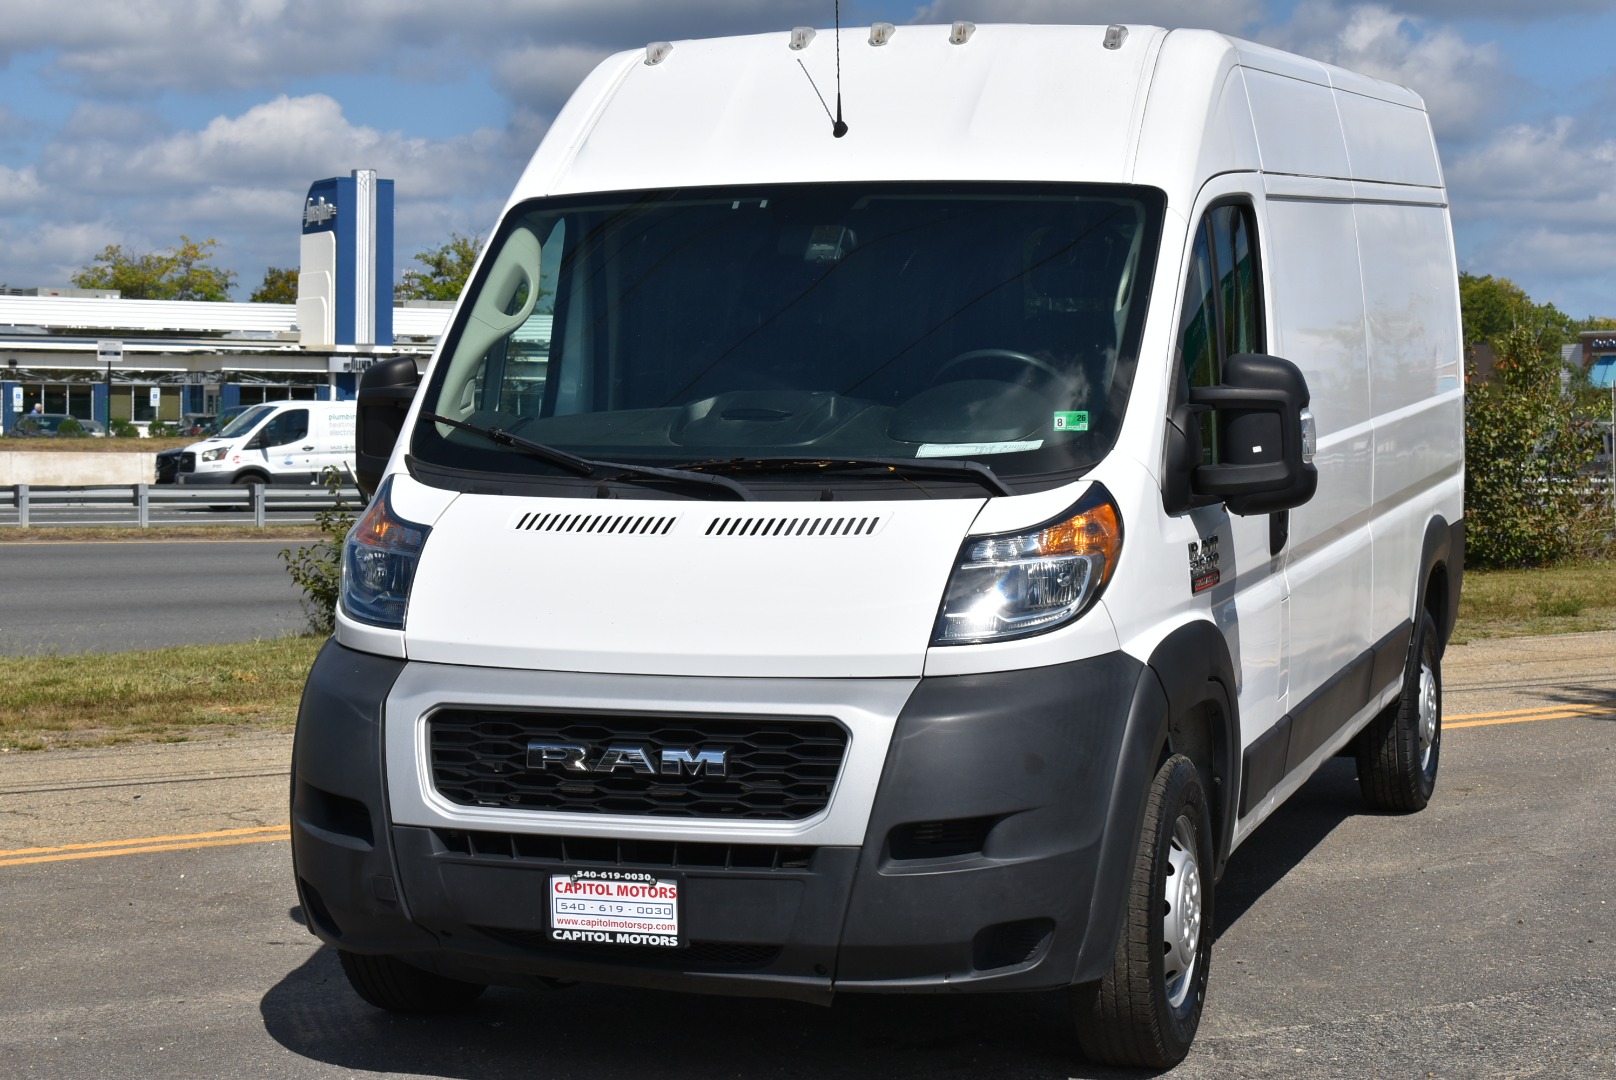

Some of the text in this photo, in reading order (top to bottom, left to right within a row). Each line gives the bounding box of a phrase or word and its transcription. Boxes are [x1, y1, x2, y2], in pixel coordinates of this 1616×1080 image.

[328, 413, 357, 421] plumbin
[1056, 418, 1063, 427] 8
[1076, 414, 1086, 422] 26
[527, 742, 728, 777] RAM
[577, 870, 651, 881] 540-619-0030
[554, 881, 677, 899] CAPITOL MOTORS
[556, 917, 676, 931] www.capitolmotorscp.com
[552, 930, 678, 947] CAPITOL MOTORS
